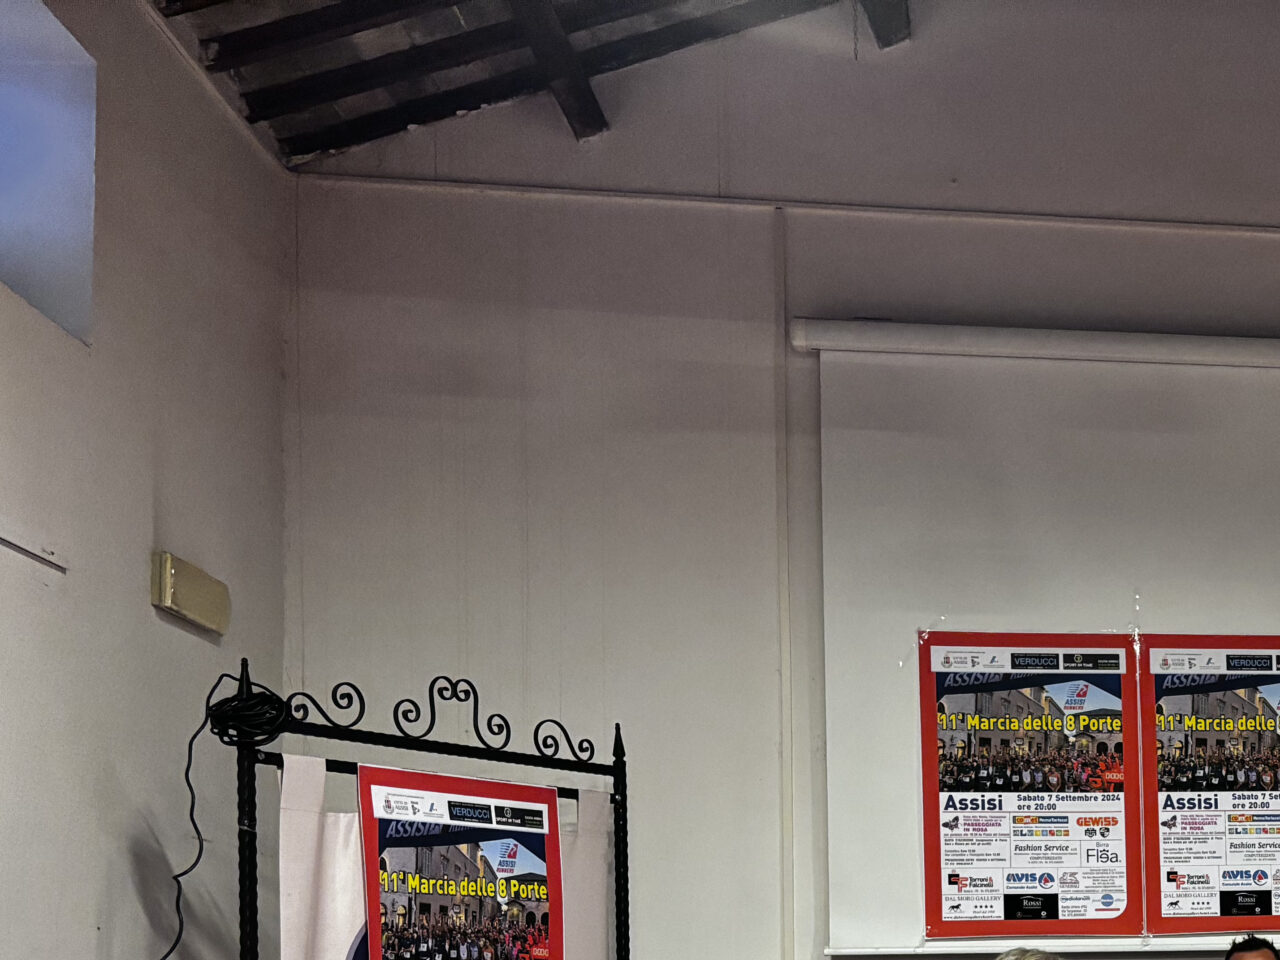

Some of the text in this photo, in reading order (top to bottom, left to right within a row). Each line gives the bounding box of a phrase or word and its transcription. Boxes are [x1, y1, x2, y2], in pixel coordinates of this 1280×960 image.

[967, 715, 1020, 730] Marcia
[1023, 715, 1062, 730] delle
[1066, 716, 1074, 730] 8
[1080, 716, 1121, 730] Porte
[1185, 716, 1233, 730] Marcia
[1238, 716, 1275, 730] delle
[944, 795, 1002, 810] Assisi
[1163, 794, 1218, 810] Assisi
[451, 807, 490, 819] VERDUCCI
[1015, 844, 1041, 852] Fashion
[1006, 873, 1037, 882] AVIS
[1222, 870, 1251, 879] AVIS
[407, 874, 456, 895] Marcia
[460, 877, 495, 897] delle
[498, 881, 507, 898] 8
[511, 883, 547, 899] Porte
[1023, 899, 1042, 907] Rossi
